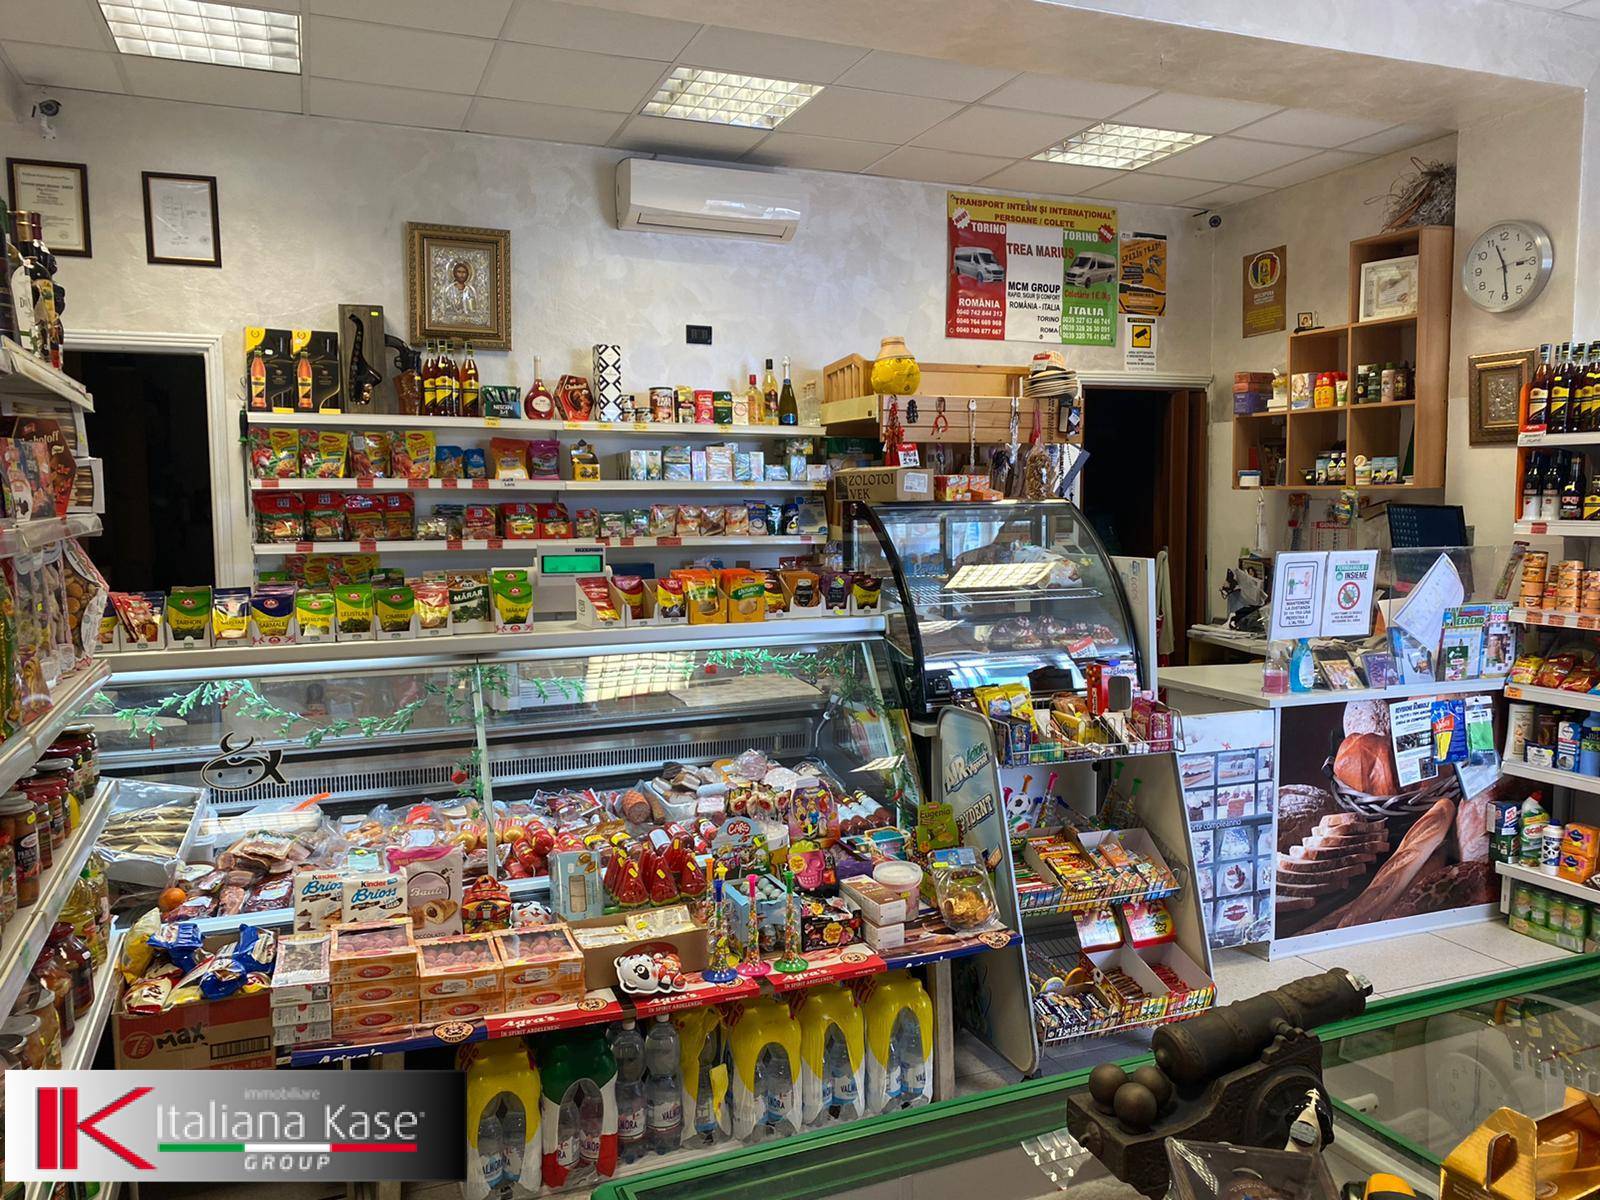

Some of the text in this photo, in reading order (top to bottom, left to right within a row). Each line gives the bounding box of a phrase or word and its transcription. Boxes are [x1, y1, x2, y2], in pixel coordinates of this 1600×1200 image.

[954, 198, 1004, 210] TRANSPORT
[1007, 202, 1038, 212] INTERN
[994, 214, 1037, 225] PERSOANE
[1044, 218, 1075, 228] COLETE
[971, 222, 1006, 235] TORINO
[1064, 230, 1098, 242] TORINO
[1500, 232, 1509, 240] 12
[1007, 242, 1075, 259] TREA MARIUS
[1525, 241, 1533, 251] 2
[1478, 251, 1487, 261] 10
[1528, 256, 1536, 265] 3
[1475, 267, 1482, 277] 9
[1008, 281, 1061, 294] MCM GROUP
[1479, 282, 1486, 290] 8
[1516, 285, 1523, 294] 5
[1488, 290, 1495, 300] 7
[1502, 292, 1509, 300] 6
[958, 297, 1000, 308] ROMÂNIA
[1009, 301, 1038, 310] ROMÂNIA
[1042, 302, 1060, 311] ITALIA
[1069, 307, 1104, 316] ITALIA
[849, 473, 894, 486] ZOLOTOI
[850, 488, 870, 500] VEK
[946, 756, 967, 791] AIR
[920, 808, 950, 819] Eugenia
[727, 821, 751, 835] CARS
[1204, 819, 1242, 831] compleanno
[351, 887, 398, 903] Brioss
[782, 968, 828, 982] Agra's
[648, 992, 698, 1006] Agra's
[656, 1004, 671, 1012] SPIRIT
[501, 1015, 558, 1030] Agra's
[509, 1028, 526, 1036] SPIRIT
[527, 1024, 560, 1035] ARDELENESC
